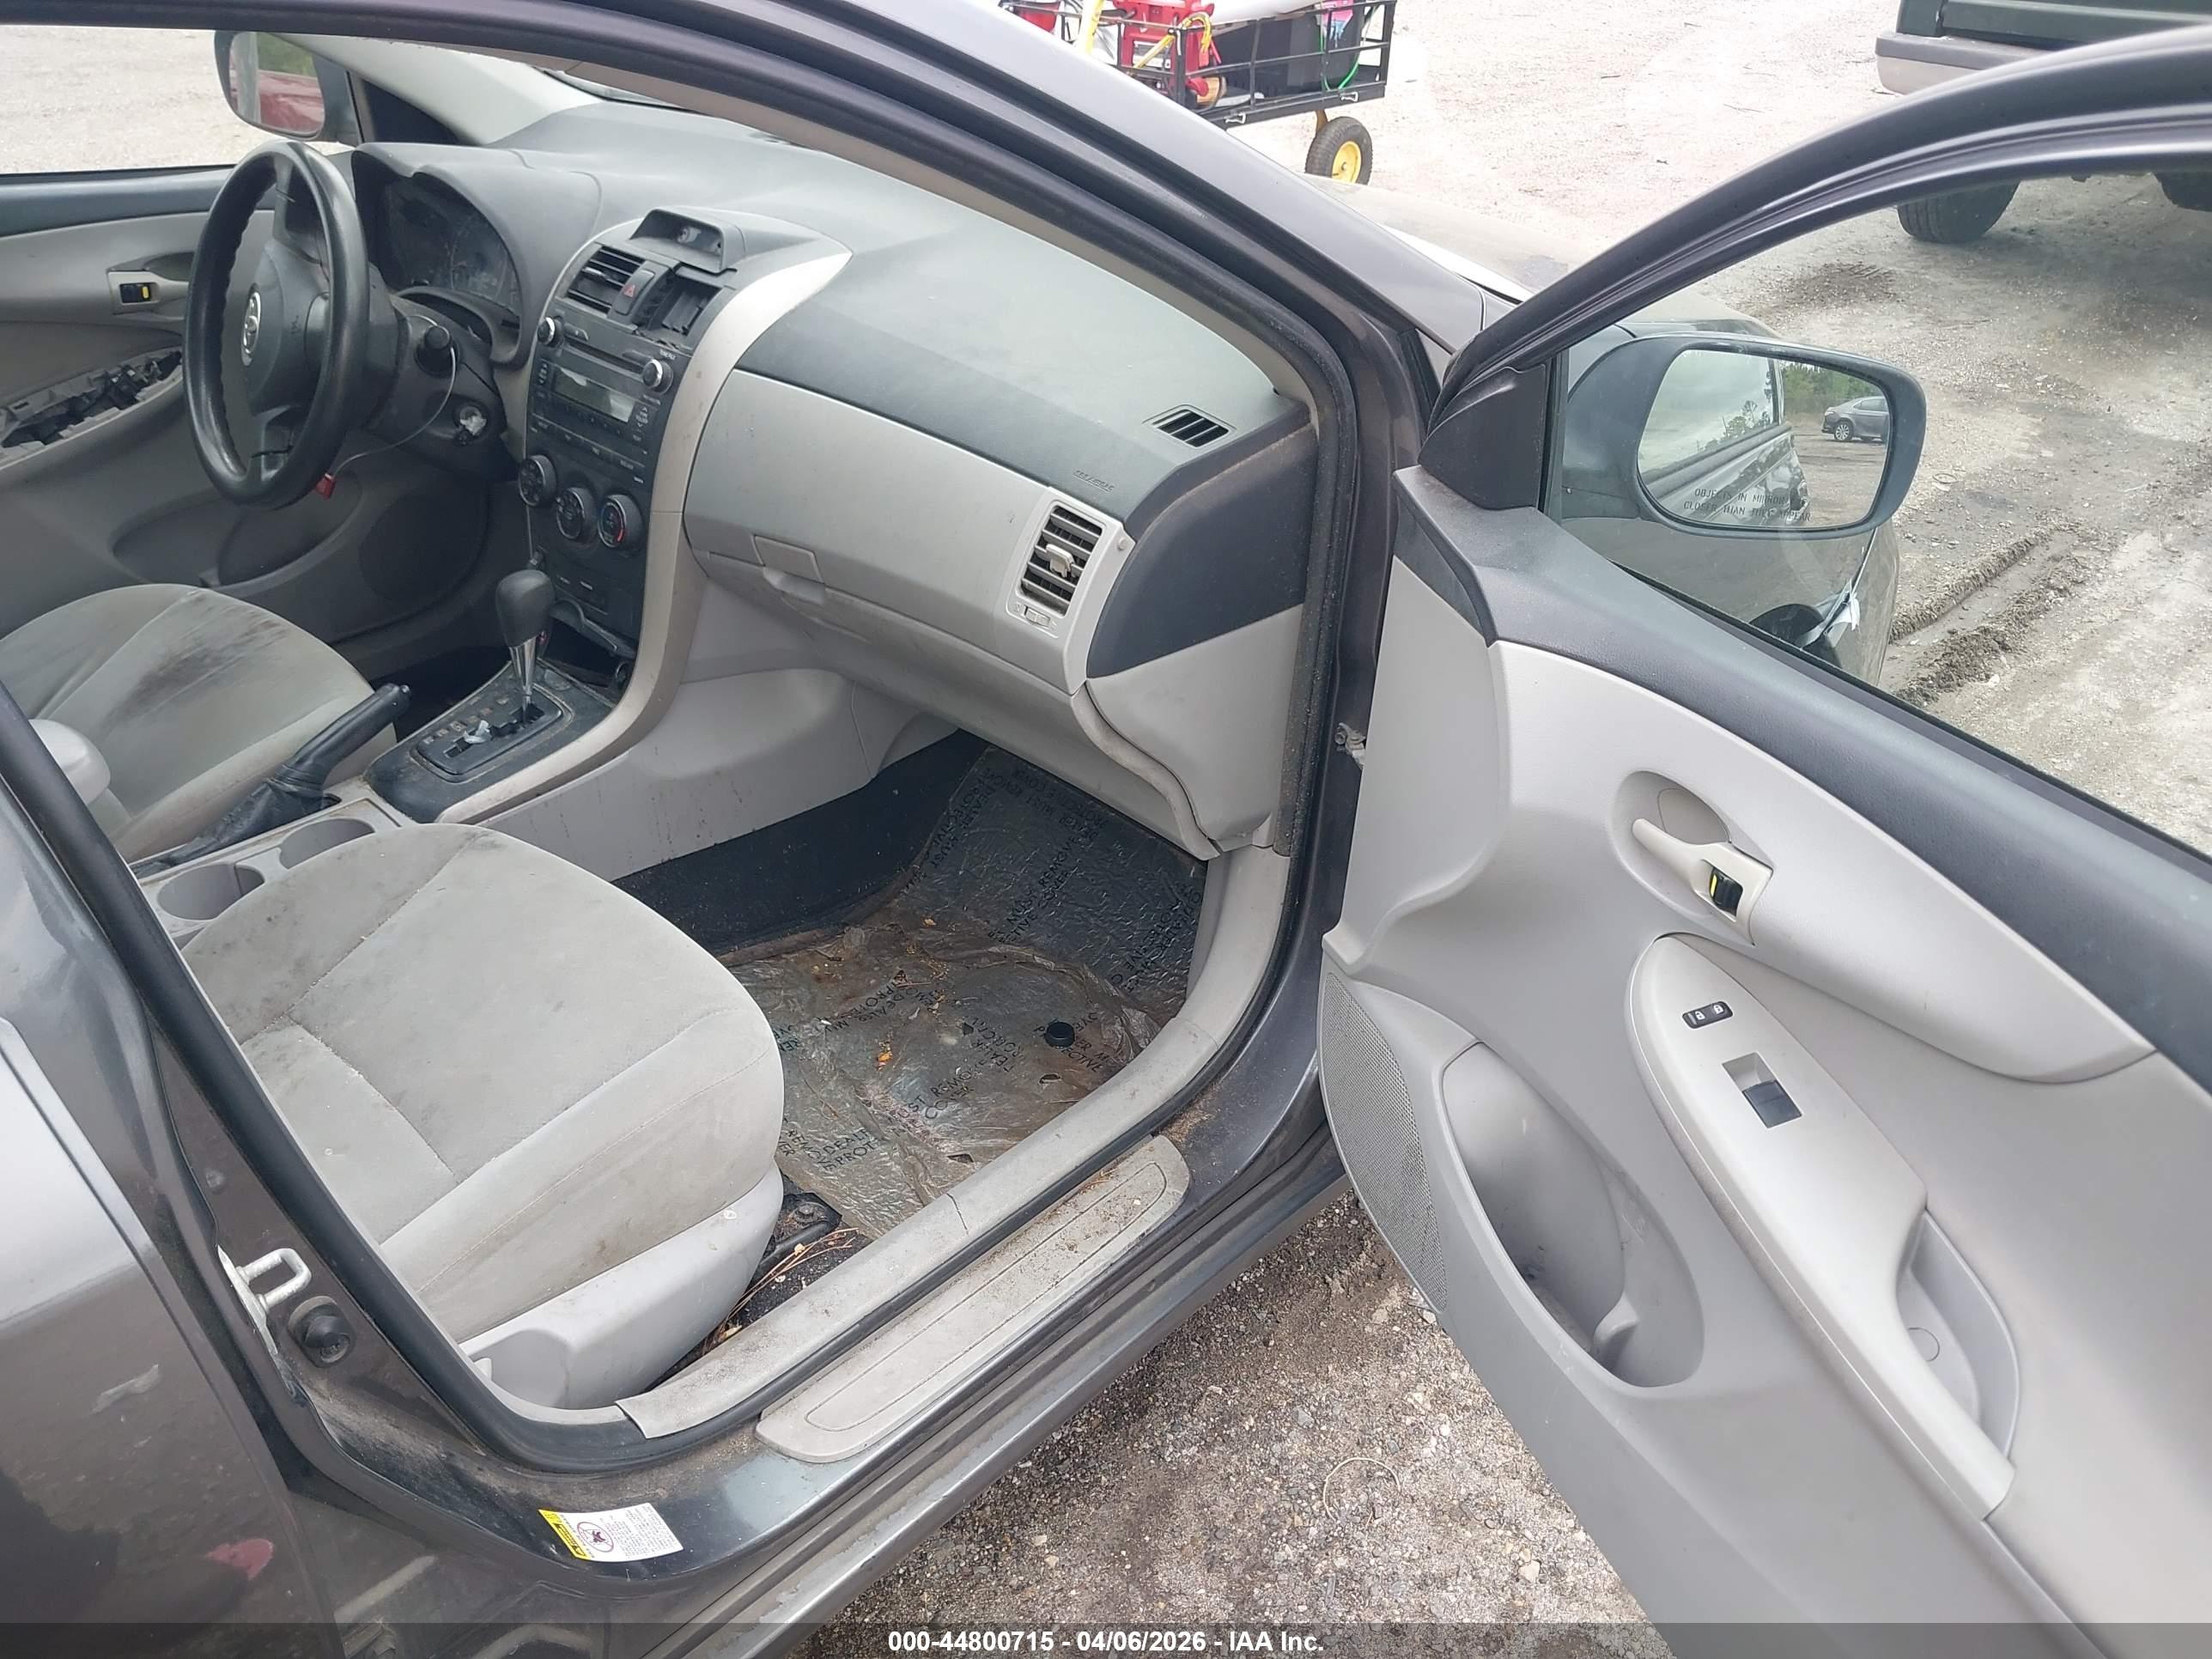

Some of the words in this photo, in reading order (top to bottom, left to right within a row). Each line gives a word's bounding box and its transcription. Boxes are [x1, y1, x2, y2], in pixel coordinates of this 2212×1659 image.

[1694, 488, 1732, 500] OBJECTS
[1737, 493, 1747, 501] IN
[1723, 505, 1746, 515] THAN
